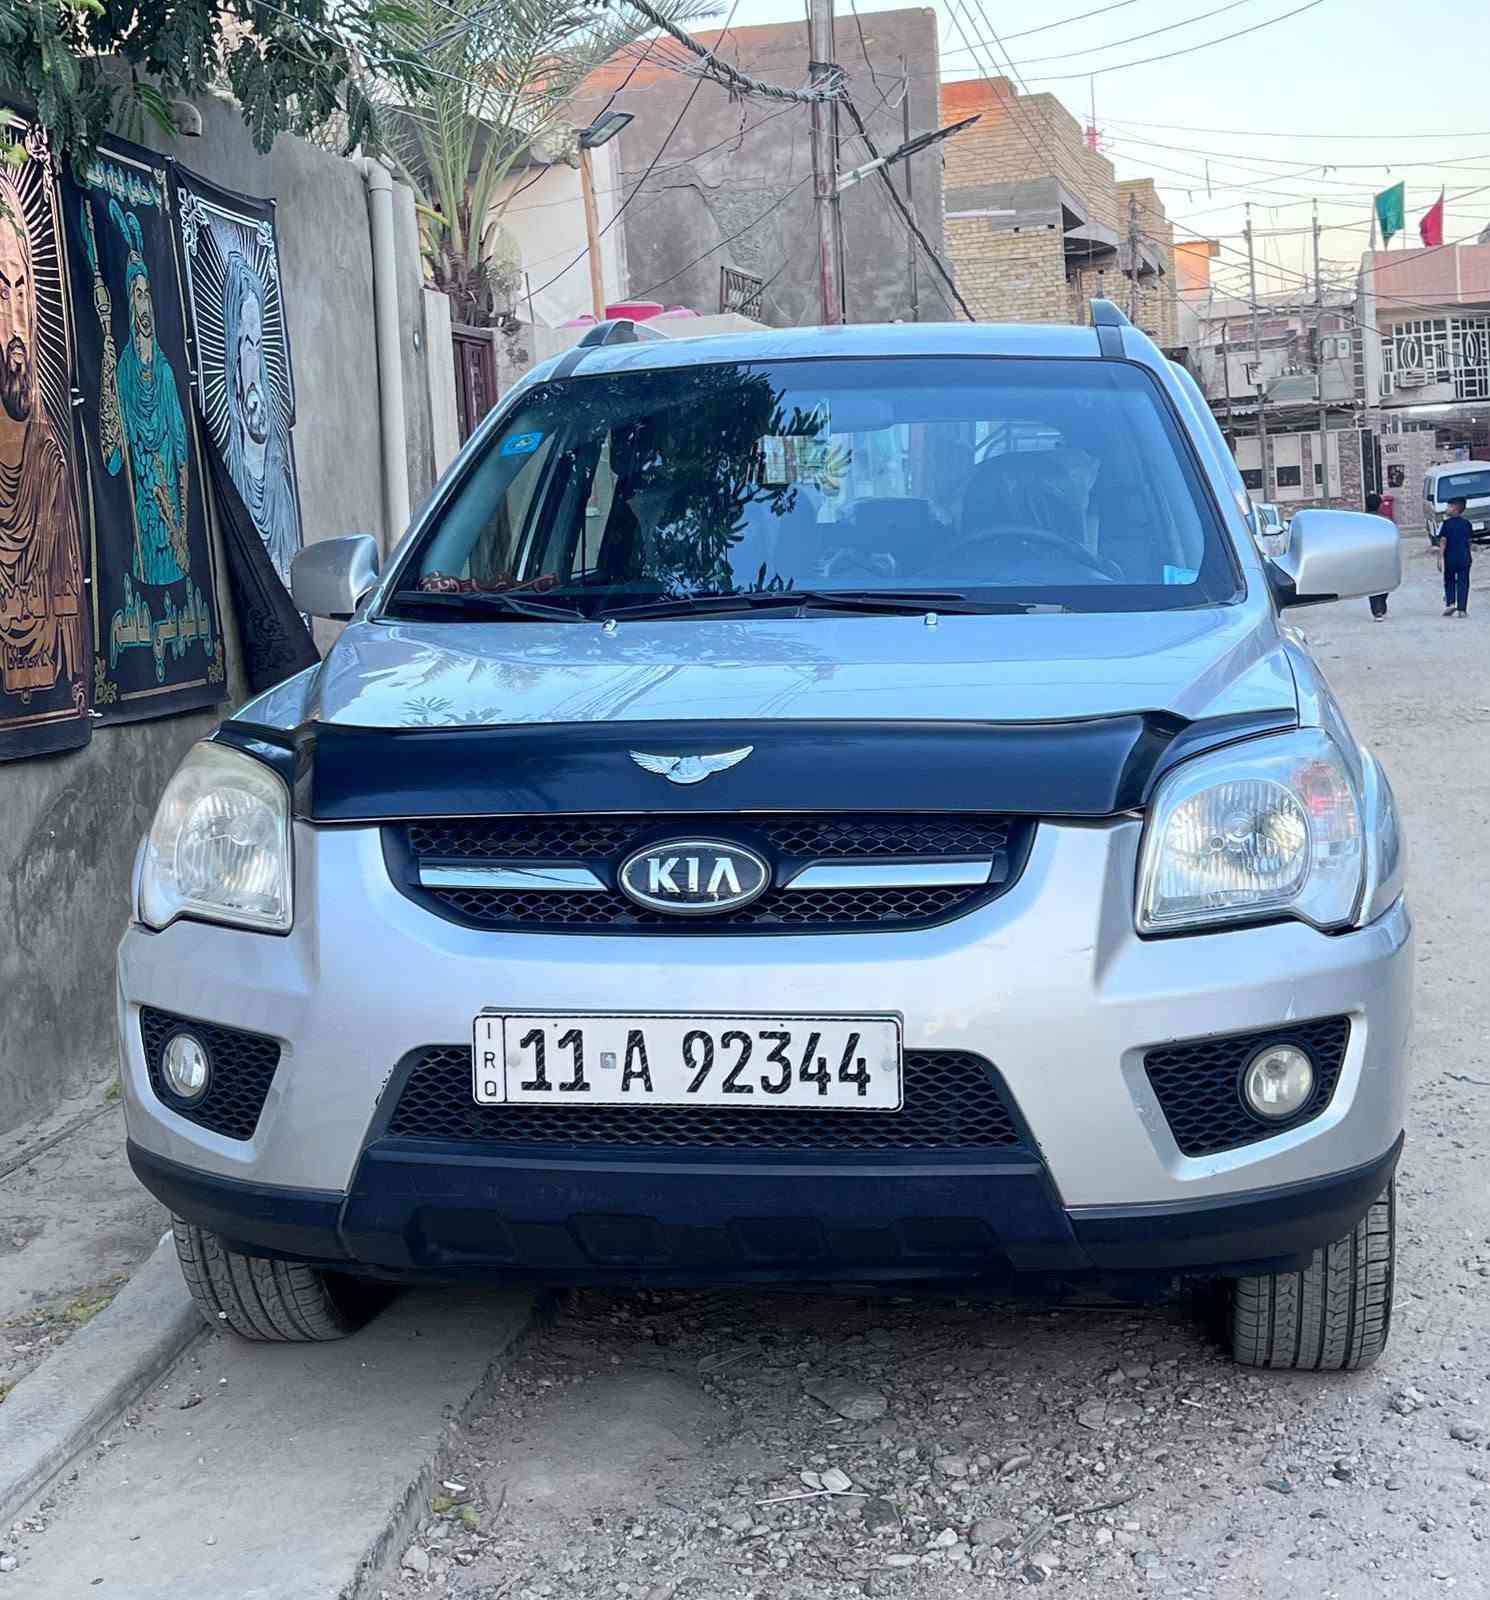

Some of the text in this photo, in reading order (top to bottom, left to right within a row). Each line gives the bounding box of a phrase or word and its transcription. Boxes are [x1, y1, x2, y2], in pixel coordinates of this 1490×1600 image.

[647, 857, 742, 894] KIA
[520, 1029, 871, 1096] 11 A 92344
